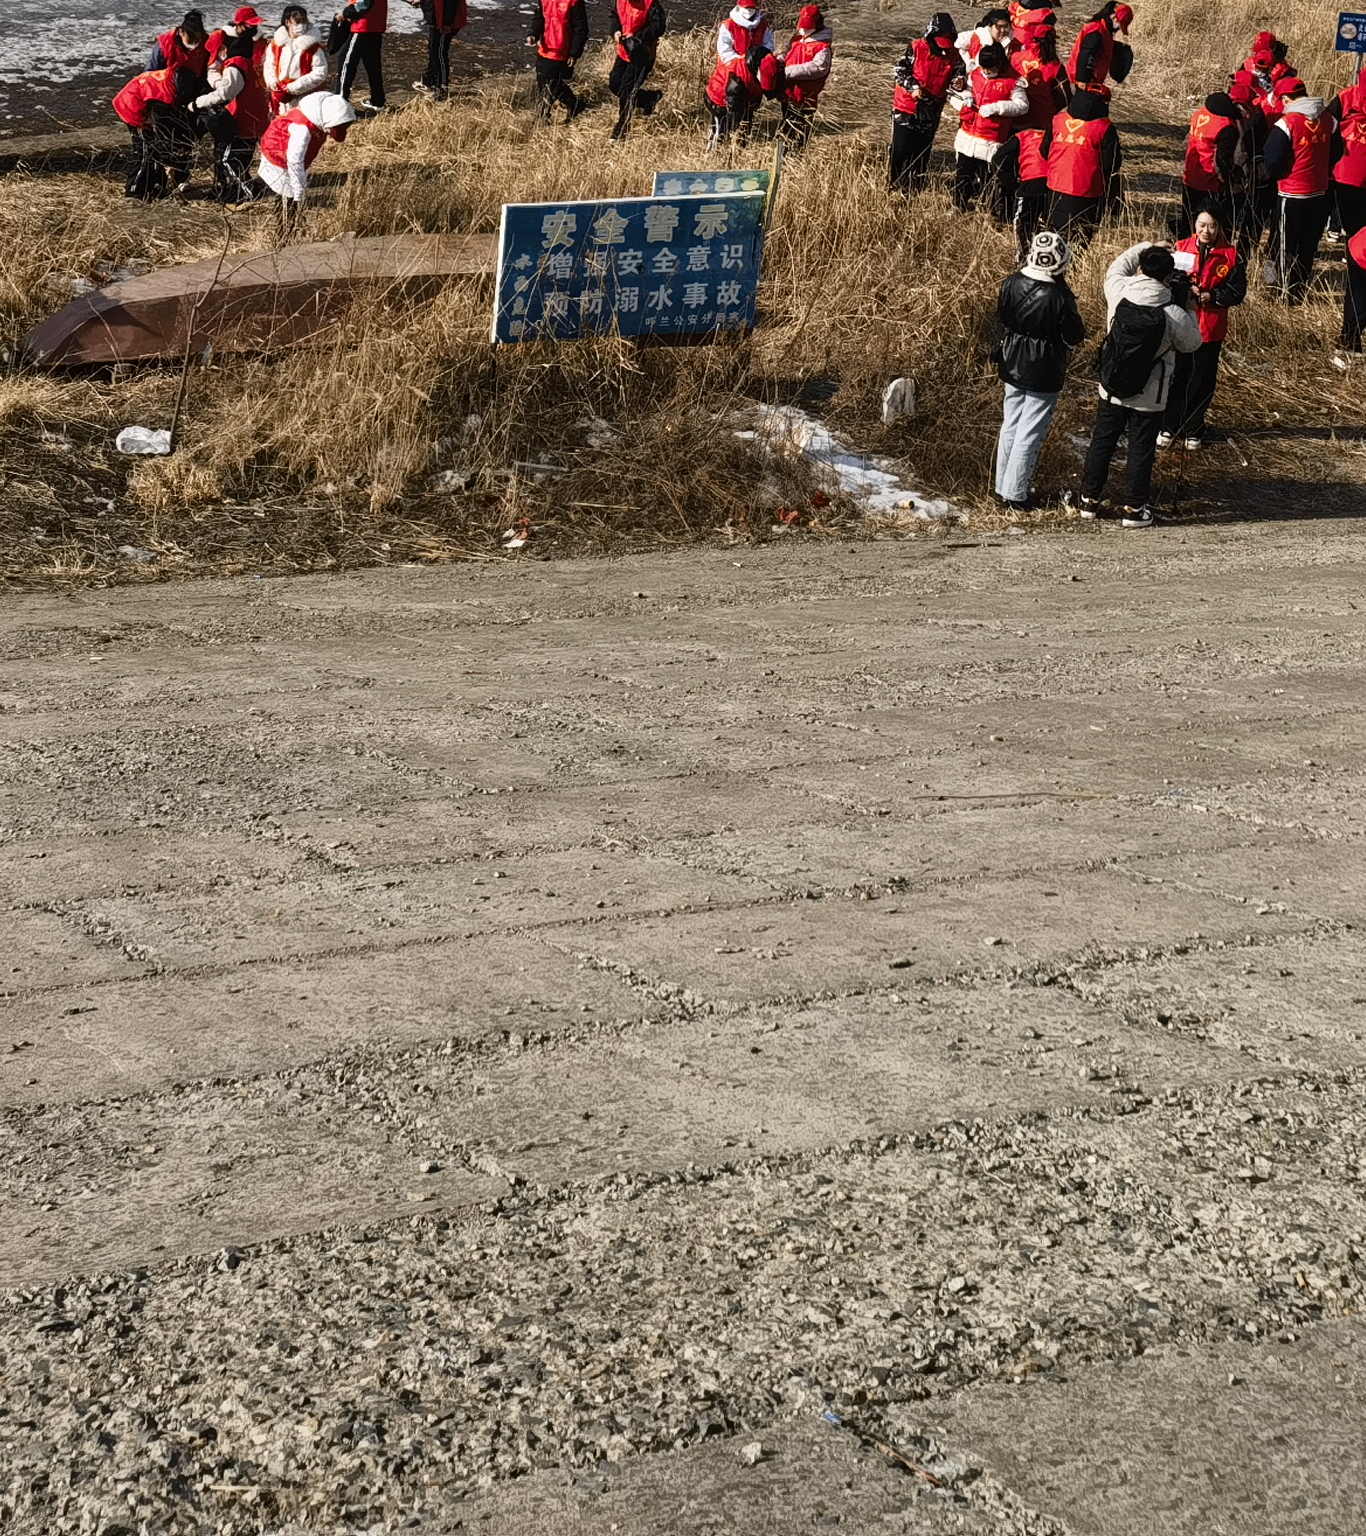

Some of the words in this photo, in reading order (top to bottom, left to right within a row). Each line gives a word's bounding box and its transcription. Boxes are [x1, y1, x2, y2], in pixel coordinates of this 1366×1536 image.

[541, 204, 729, 248] 安全警示
[544, 280, 742, 317] 预防溺水事故
[645, 312, 739, 328] 呼兰公安分局
